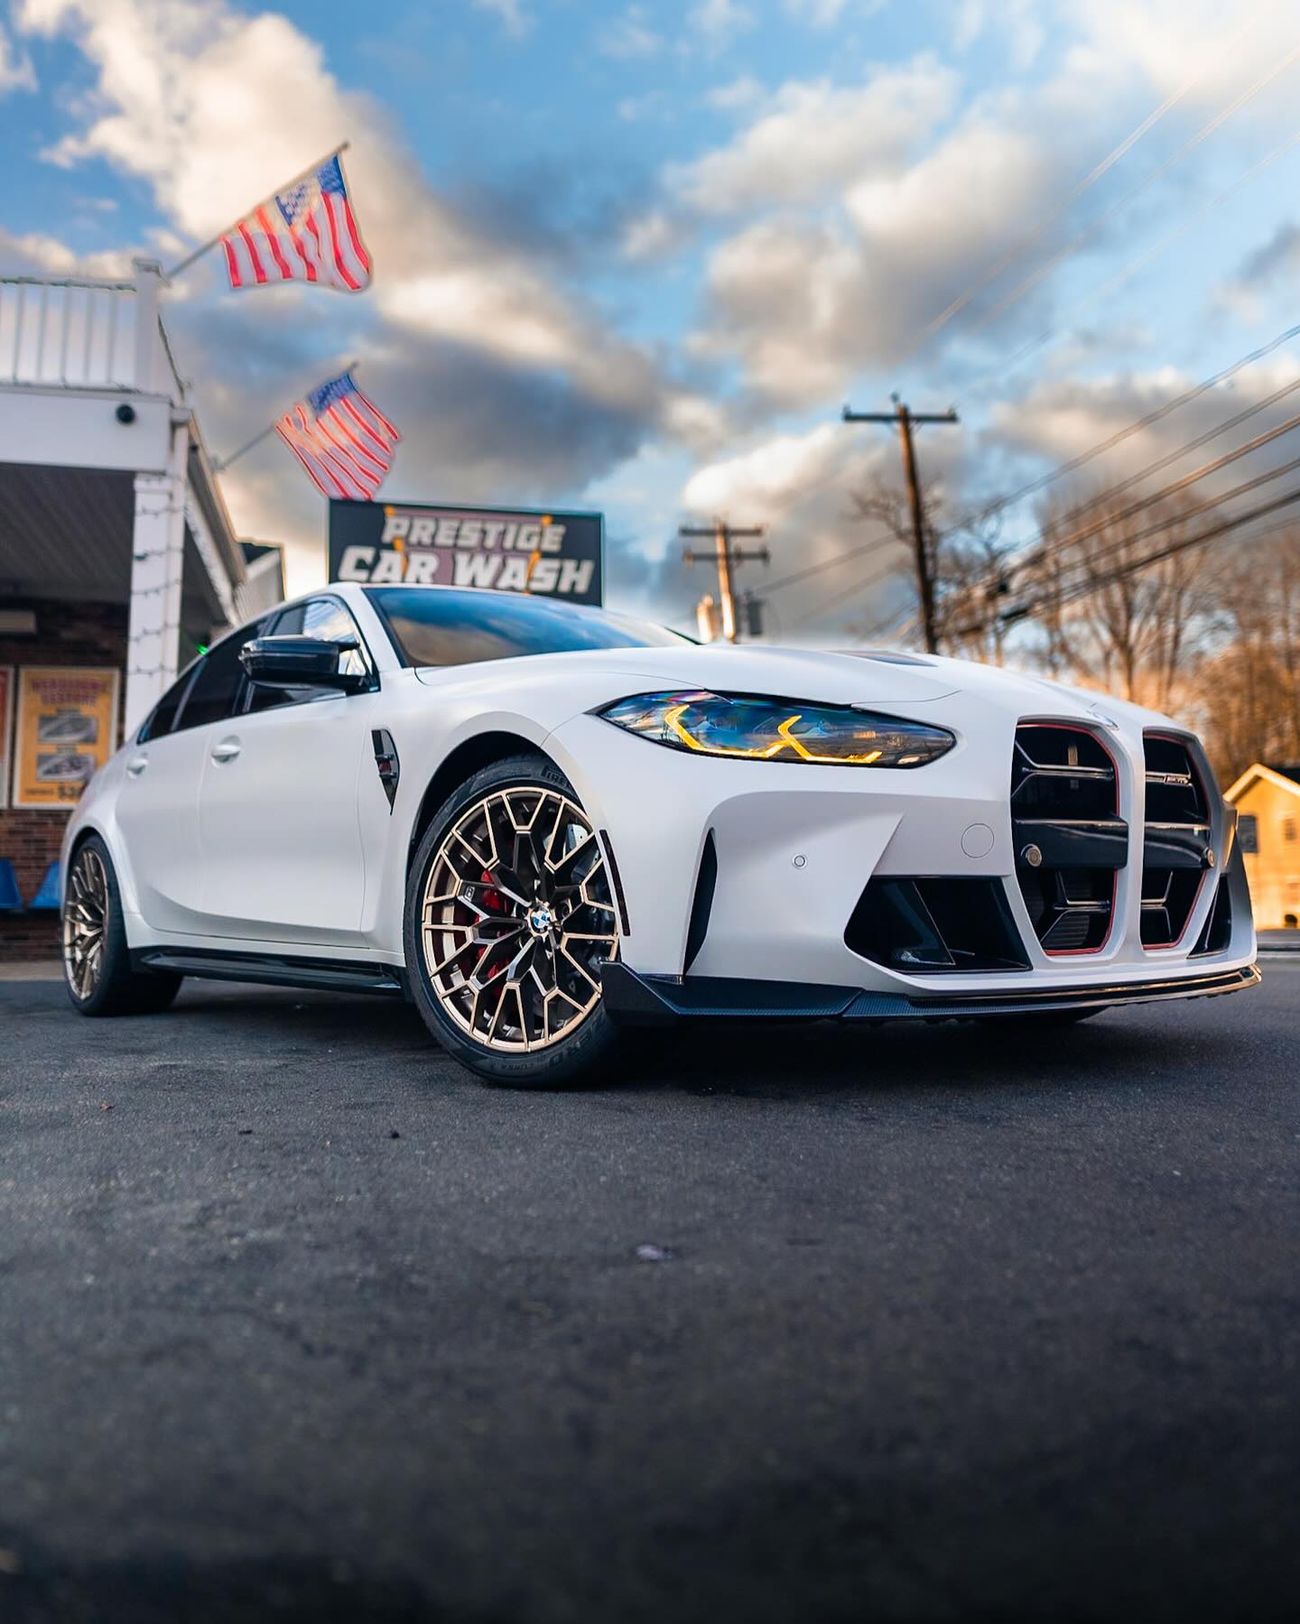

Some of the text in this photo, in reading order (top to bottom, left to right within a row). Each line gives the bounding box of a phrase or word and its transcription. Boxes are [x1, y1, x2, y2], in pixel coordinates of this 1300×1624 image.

[381, 515, 566, 552] PRESTIGE
[338, 545, 595, 593] CAR WASH
